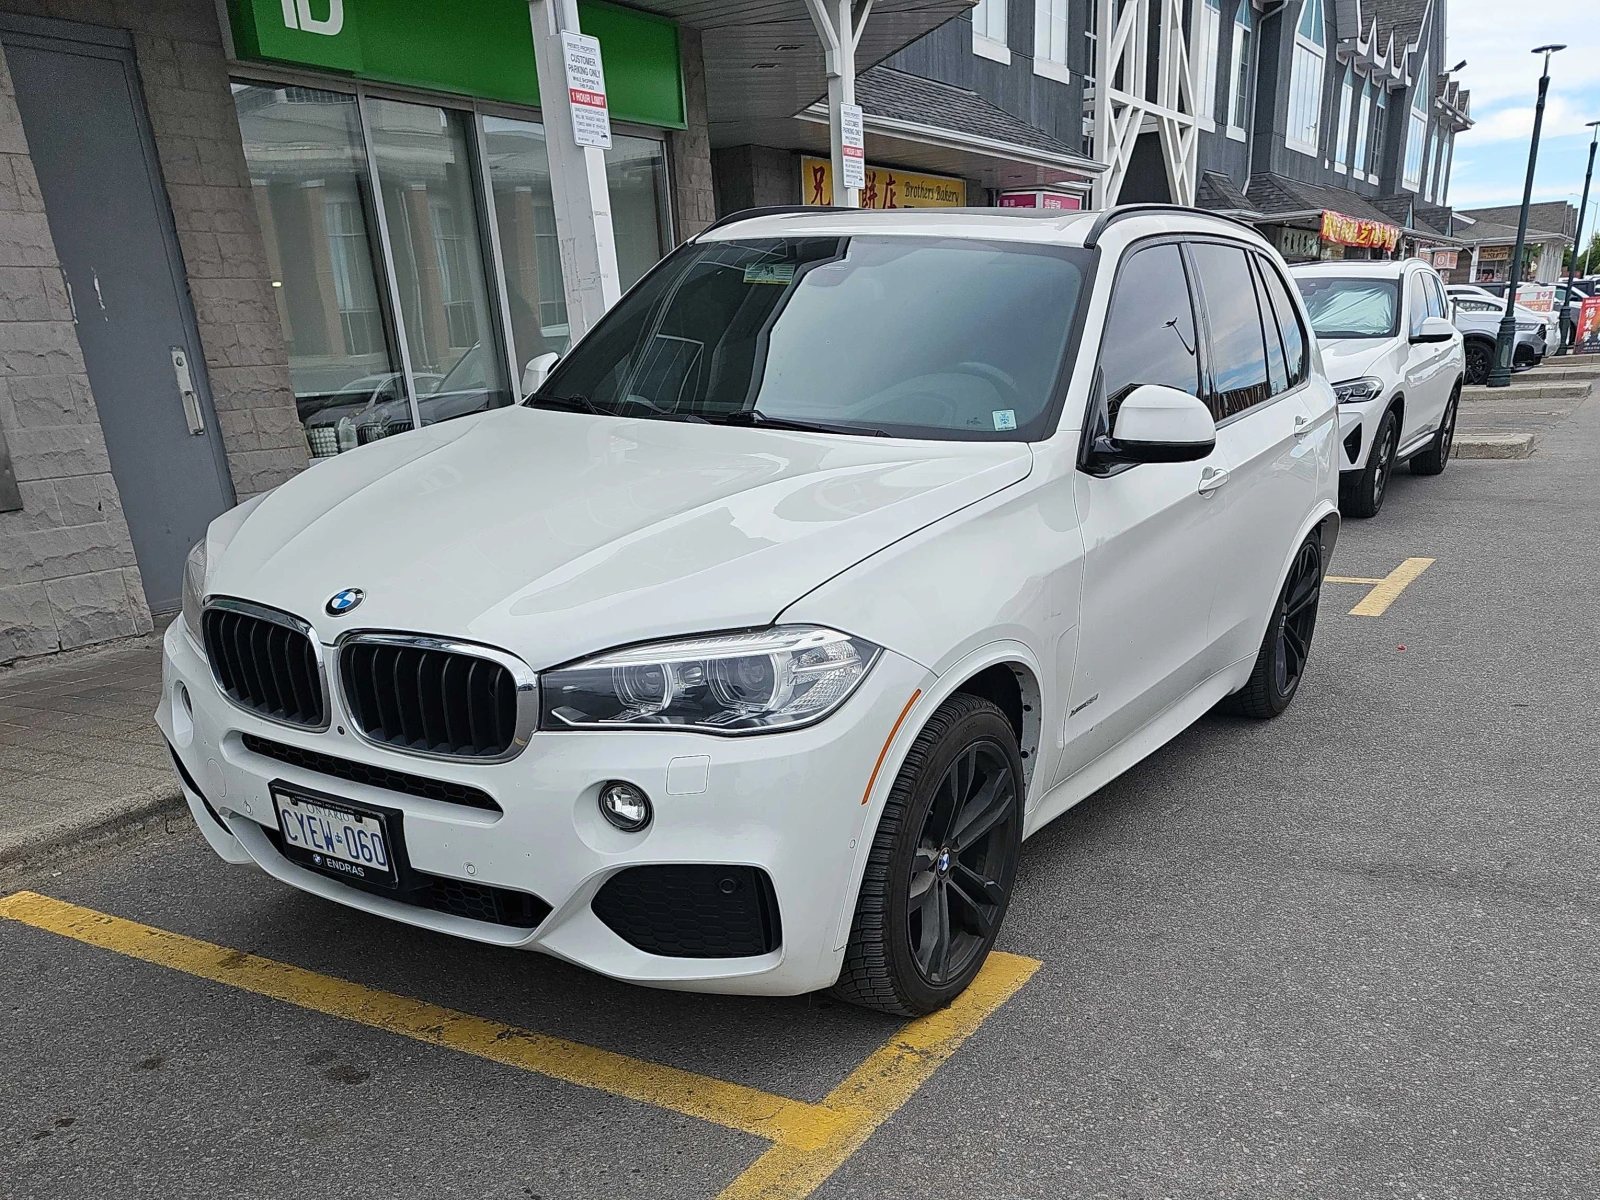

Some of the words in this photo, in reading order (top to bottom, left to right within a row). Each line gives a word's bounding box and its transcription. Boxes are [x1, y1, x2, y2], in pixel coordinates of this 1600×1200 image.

[570, 53, 596, 66] CUSTOMER
[568, 63, 588, 76] PARKING
[589, 68, 600, 78] ONLY
[575, 92, 591, 103] HOUR
[591, 95, 604, 106] LIMIT
[904, 182, 934, 200] Brothers
[936, 185, 959, 205] Bakery
[306, 803, 350, 822] ONTARIO
[281, 808, 337, 853] CYEW
[343, 825, 387, 867] 060
[326, 857, 365, 877] ENDRAS
